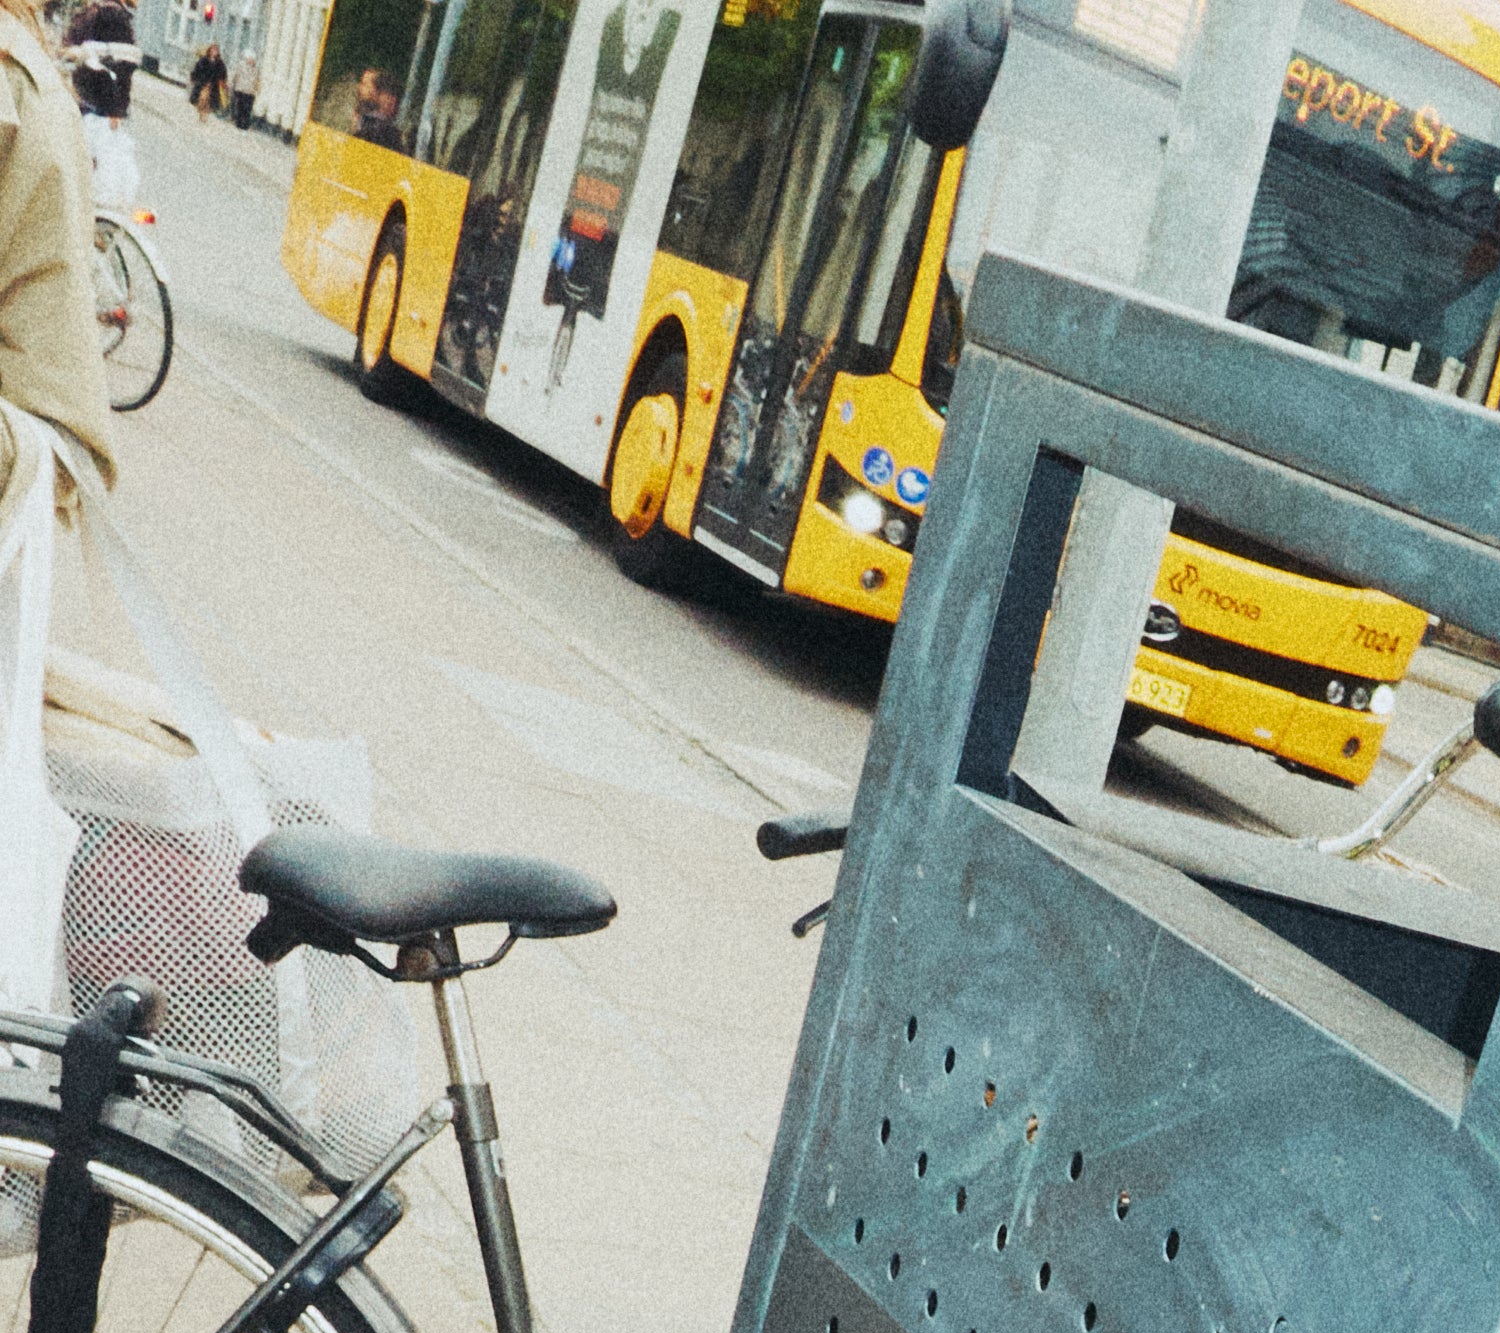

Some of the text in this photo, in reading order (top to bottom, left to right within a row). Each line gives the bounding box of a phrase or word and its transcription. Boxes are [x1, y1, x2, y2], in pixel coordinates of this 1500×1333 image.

[1405, 104, 1458, 173] St.
[1196, 586, 1262, 622] movia
[1350, 623, 1401, 654] 7024
